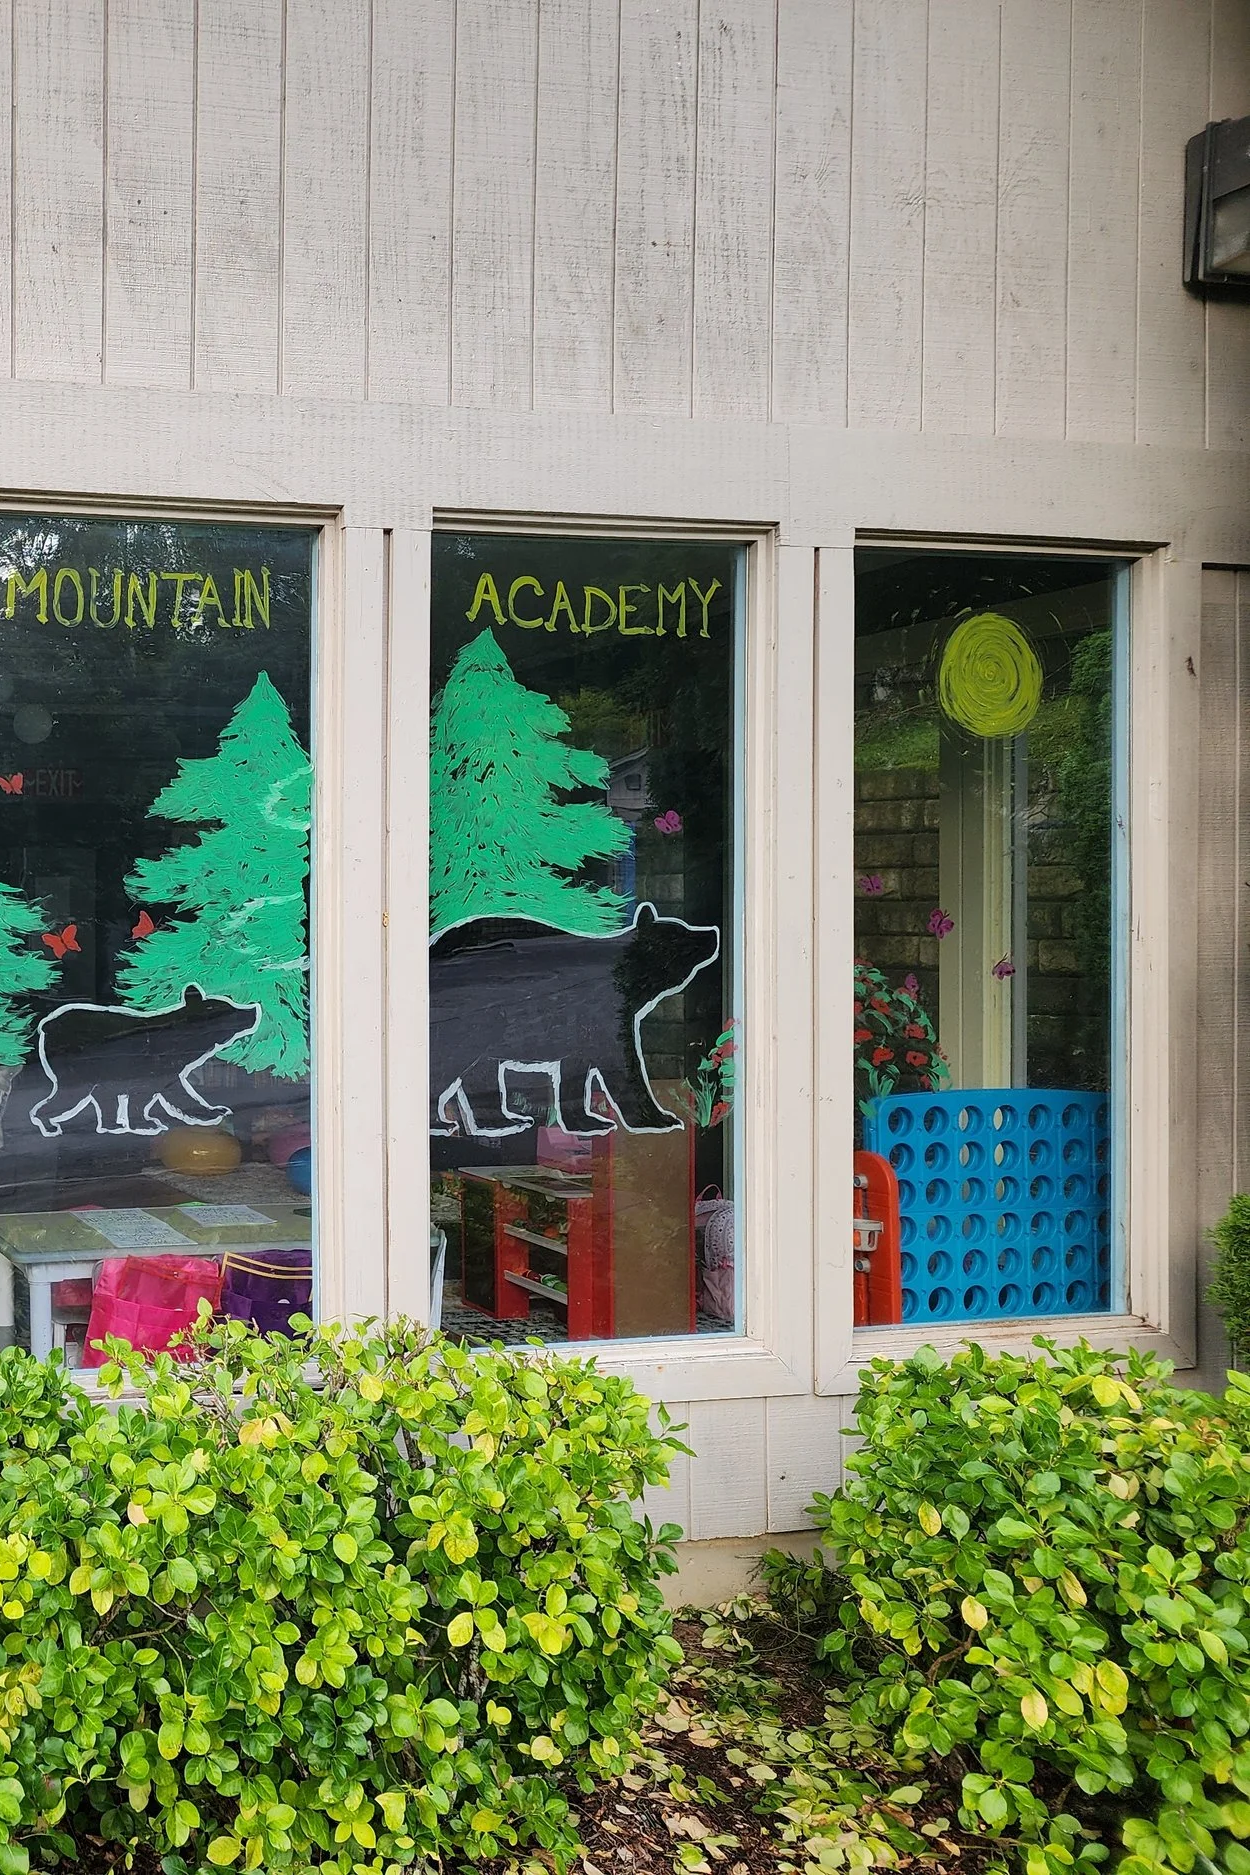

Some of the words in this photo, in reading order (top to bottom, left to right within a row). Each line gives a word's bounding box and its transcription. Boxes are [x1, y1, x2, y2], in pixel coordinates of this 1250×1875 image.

[5, 566, 272, 629] MOUNTAIN
[465, 572, 723, 638] ACADEMY
[36, 769, 76, 797] EXIT
